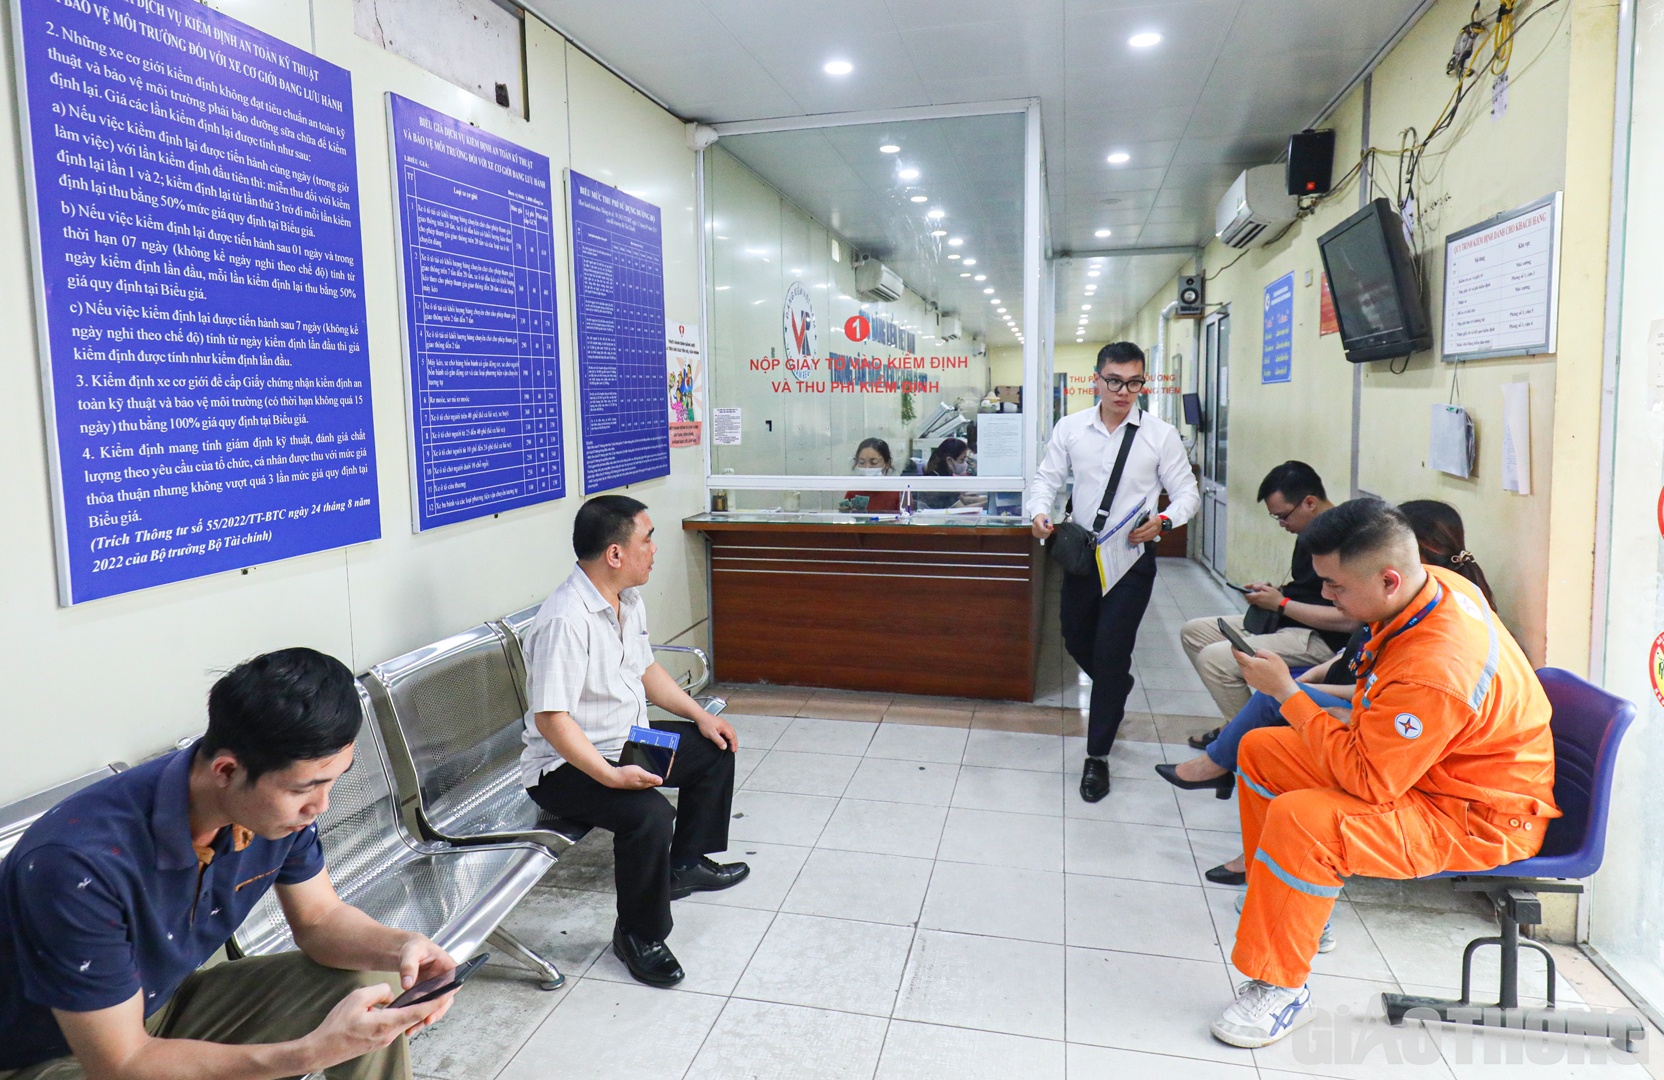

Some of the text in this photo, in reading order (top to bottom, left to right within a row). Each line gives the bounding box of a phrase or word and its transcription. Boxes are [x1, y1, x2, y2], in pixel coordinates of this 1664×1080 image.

[92, 3, 111, 25] VỆ
[112, 11, 137, 33] MÔI
[138, 21, 186, 52] TRƯỜNG
[188, 41, 207, 60] ĐỐI
[208, 50, 227, 68] VỚI
[228, 57, 242, 73] XE
[242, 64, 257, 79] CƠ
[257, 70, 277, 87] GIỚI
[278, 78, 302, 96] ĐANG
[303, 87, 320, 103] LƯU
[321, 94, 343, 112] HÀNH
[166, 6, 182, 27] VỤ
[184, 14, 211, 37] KIỂM
[213, 27, 237, 48] ĐỊNH
[239, 39, 251, 53] AN
[252, 44, 277, 64] TOÀN
[278, 55, 290, 69] KỸ
[291, 60, 319, 82] THUẬT
[45, 21, 345, 140] 2. Những xe cơ giới kiểm định không đạt tiêu chuẩn an toàn kỹ
[407, 172, 413, 180] TT
[853, 319, 861, 339] 1
[750, 356, 780, 373] NỘP
[825, 354, 846, 370] TỜ
[850, 354, 882, 370] VÀO
[888, 350, 925, 369] KIỂM
[930, 356, 968, 371] ĐỊNH
[772, 374, 939, 396] VÀ THU PHÍ KIỂM ĐỊNH
[88, 509, 142, 528] Biểu giá.
[90, 497, 371, 553] (Trích Thông tư số 55/2022/TT-BTC ngày 24 tháng 8 năm
[92, 530, 272, 573] 2022 của Bộ trưởng Bộ Tài chính)
